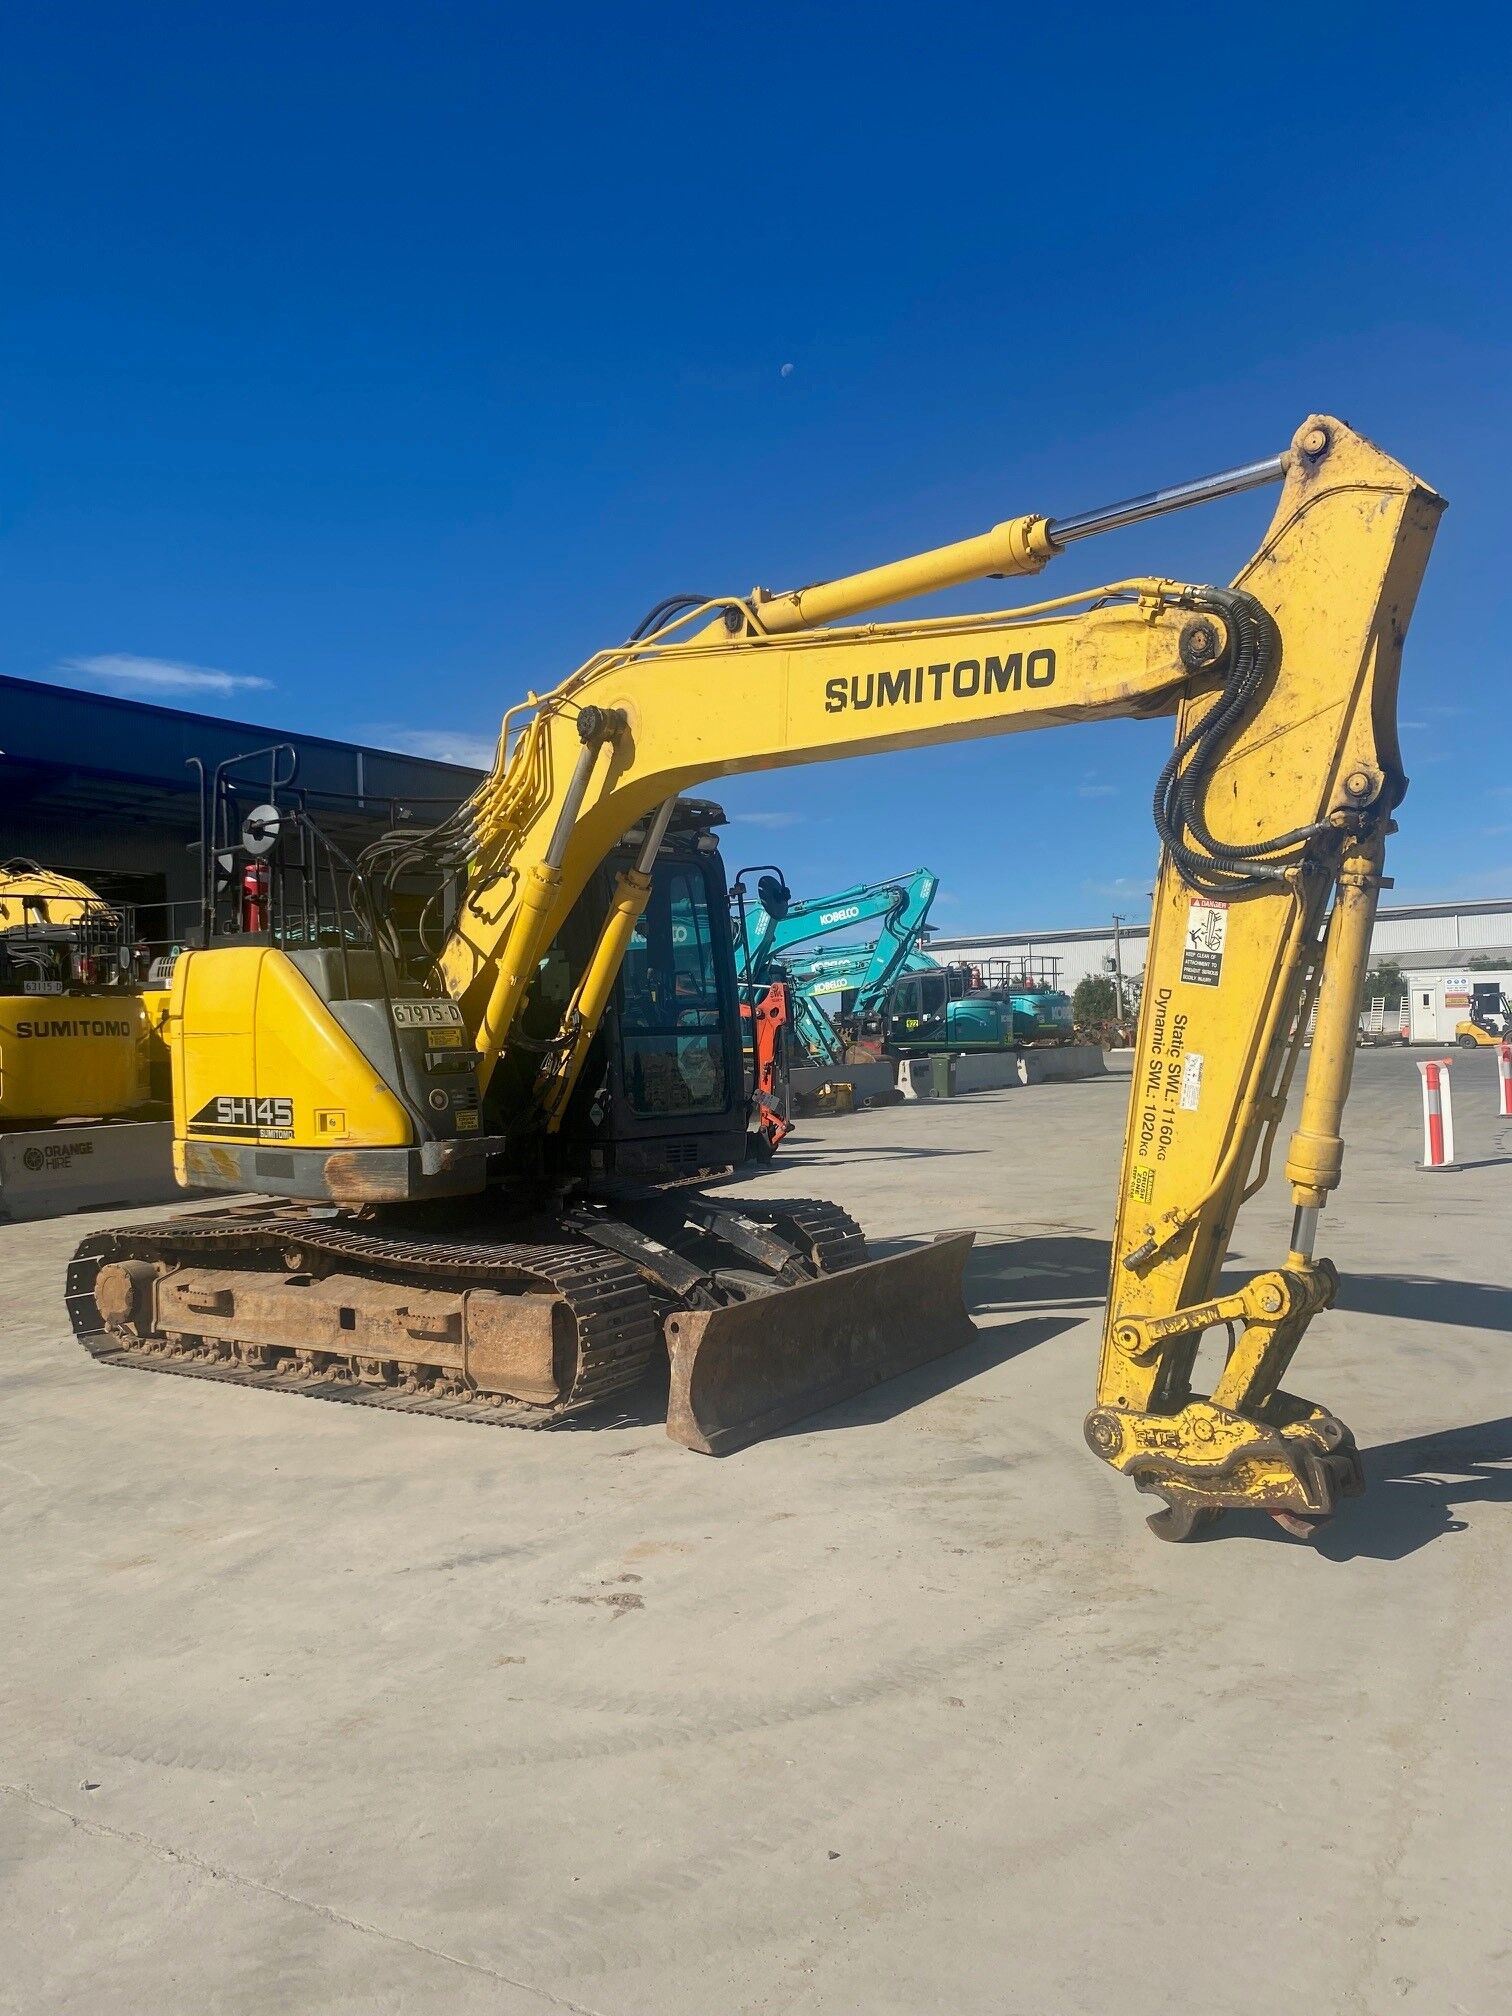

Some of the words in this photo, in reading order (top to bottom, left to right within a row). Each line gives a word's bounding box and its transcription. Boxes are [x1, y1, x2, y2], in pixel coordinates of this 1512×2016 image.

[825, 648, 1057, 714] SUMITOMO
[1201, 900, 1228, 909] DANGER
[819, 906, 860, 926] KOBELCO
[815, 978, 848, 993] KOBELCO
[16, 1020, 131, 1039] SUMITOMO
[1151, 988, 1172, 1055] Dynamic
[1170, 1014, 1188, 1058] Static
[1145, 1059, 1163, 1099] SWL:
[1164, 1063, 1181, 1103] SWL:
[217, 1097, 292, 1126] SH145
[259, 1129, 293, 1139] SUMITOMO
[44, 1141, 94, 1157] ORANGE
[45, 1156, 73, 1170] HIRE
[1134, 1172, 1142, 1195] ZONE
